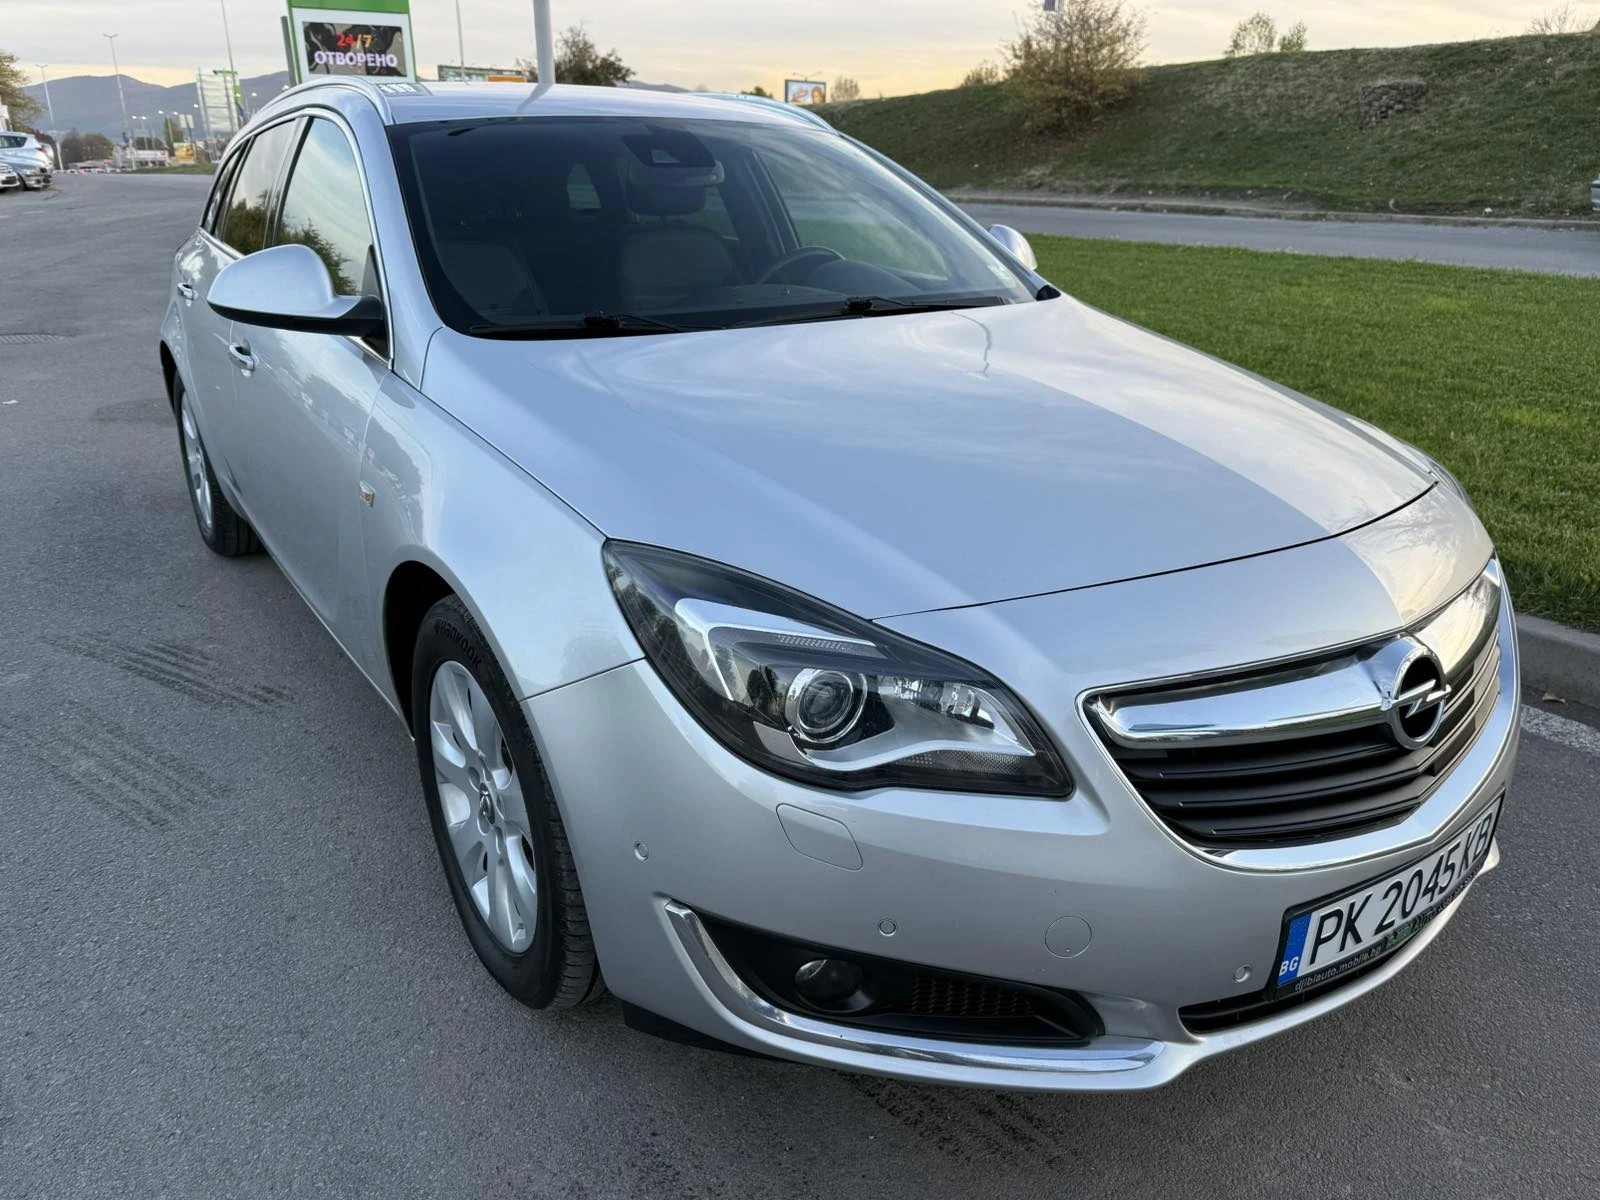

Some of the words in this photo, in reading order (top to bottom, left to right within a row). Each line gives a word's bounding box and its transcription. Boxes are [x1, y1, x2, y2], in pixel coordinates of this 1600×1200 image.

[336, 32, 374, 49] 24/7
[314, 50, 398, 68] ОТВОРЕНО
[1309, 893, 1372, 966] PK
[1373, 840, 1462, 937] 2045
[1456, 812, 1493, 879] KB
[1279, 956, 1299, 976] BG
